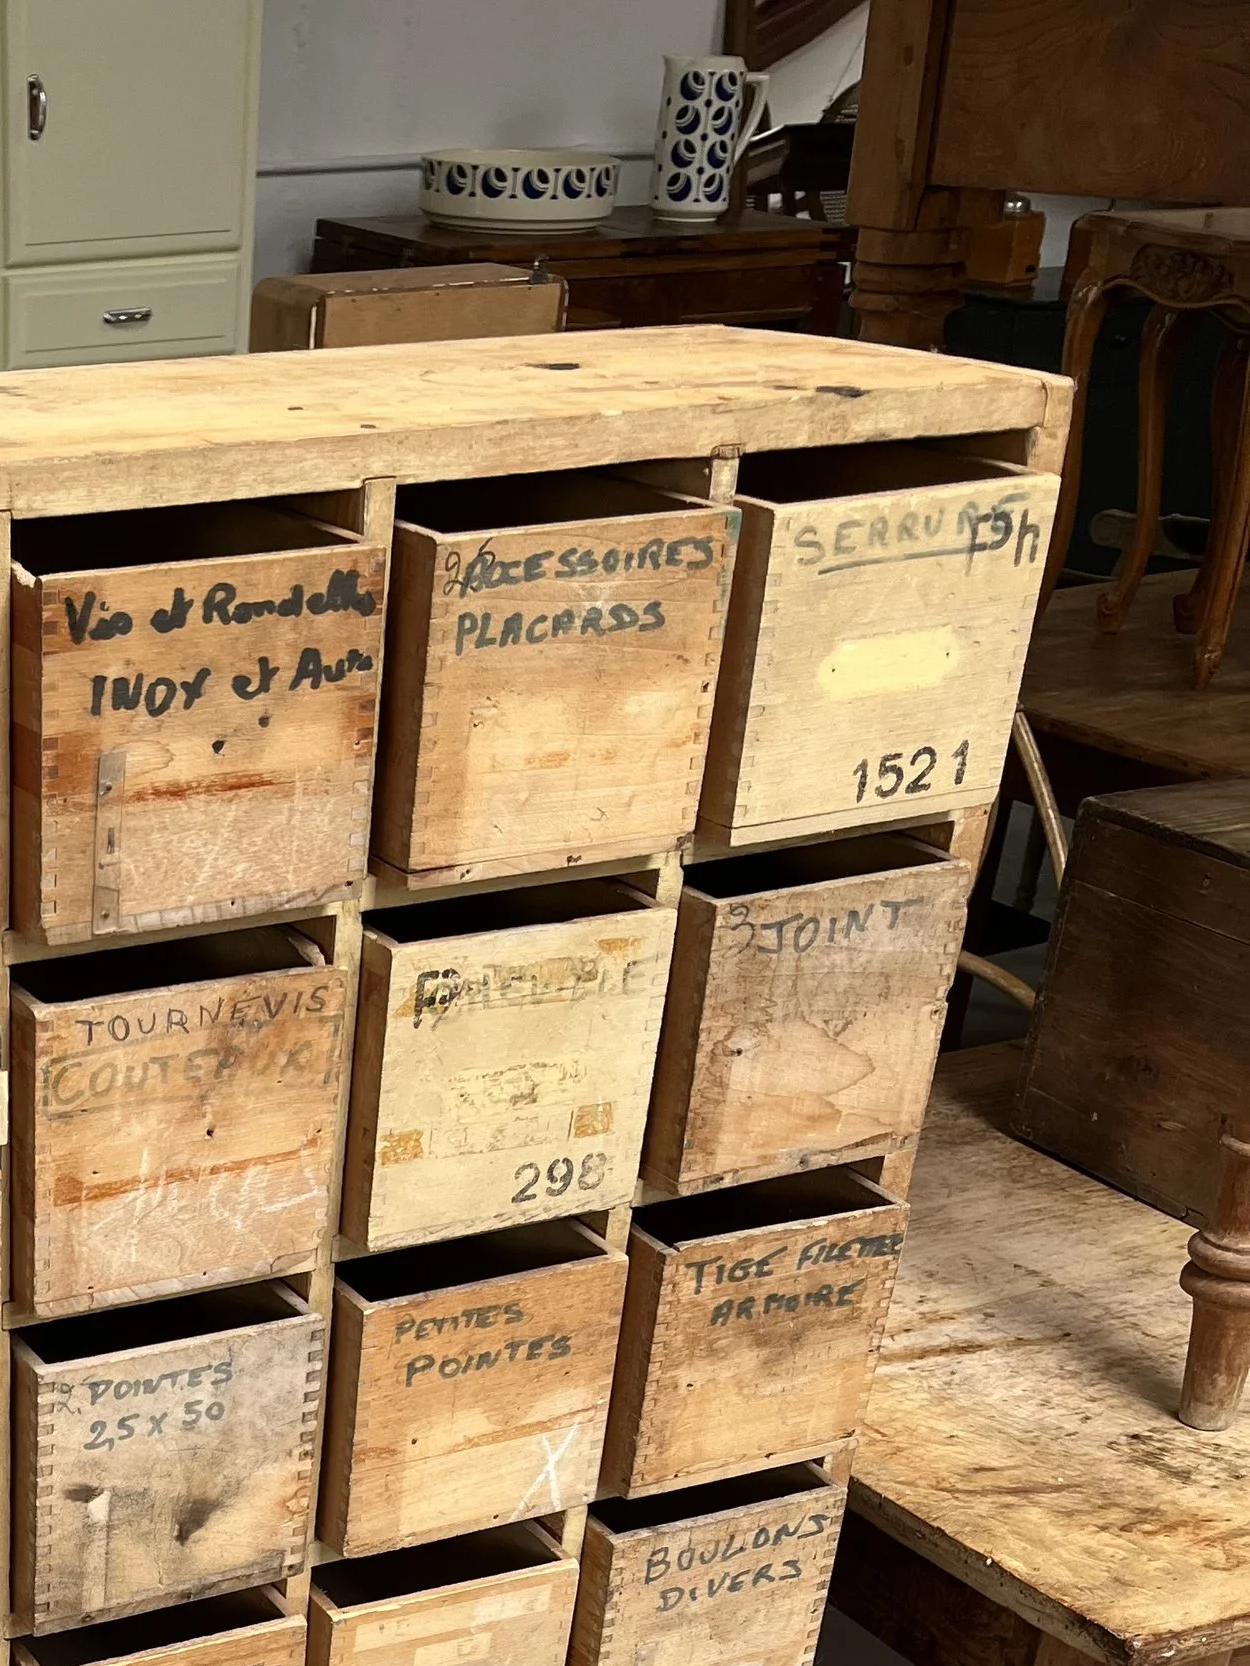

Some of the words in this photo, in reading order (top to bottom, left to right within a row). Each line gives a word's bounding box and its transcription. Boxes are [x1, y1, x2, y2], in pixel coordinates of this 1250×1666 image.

[151, 587, 195, 634] et
[454, 600, 667, 657] PLACARDS
[90, 666, 211, 718] INOX
[231, 656, 279, 700] et
[852, 738, 971, 804] 1521
[756, 895, 926, 955] JOINT
[75, 984, 331, 1046] TOURNEVIS
[510, 1151, 609, 1205] 298
[685, 1245, 788, 1295] TIGE
[395, 1302, 525, 1345] PETITES
[709, 1278, 866, 1326] ARMOIRE
[82, 1360, 233, 1406] POINTES
[405, 1334, 573, 1387] POINTES
[182, 1399, 226, 1427] 50
[644, 1513, 831, 1585] BOULONS
[655, 1559, 803, 1613] DIVERS
